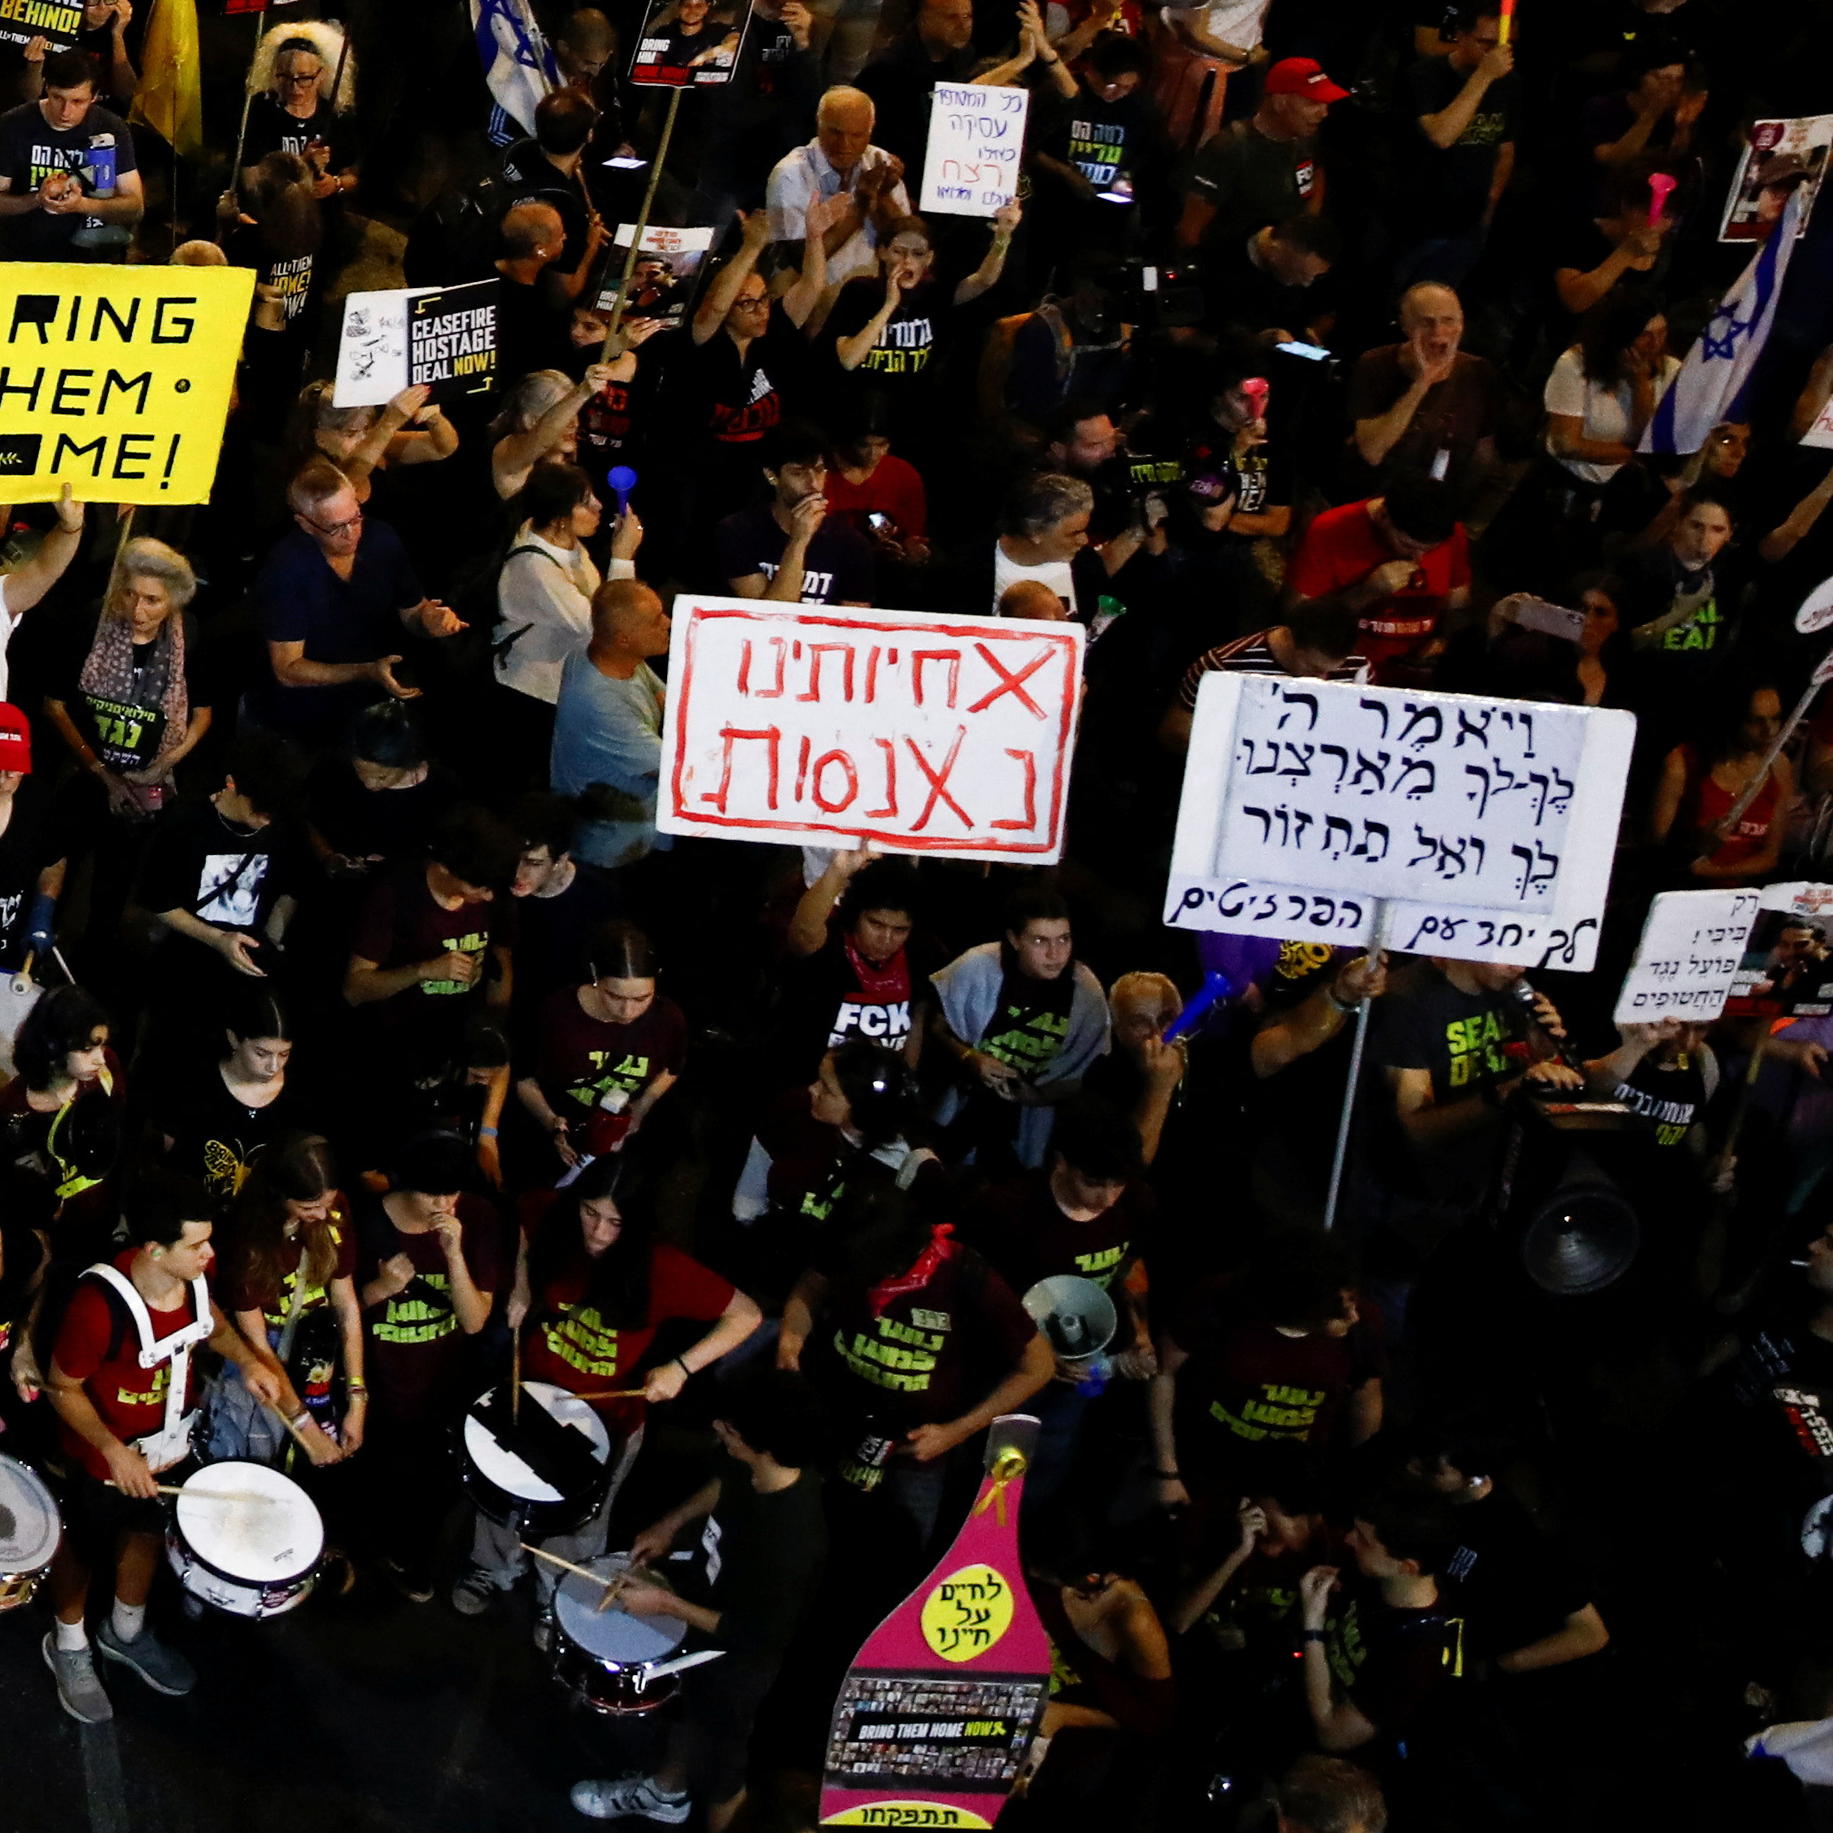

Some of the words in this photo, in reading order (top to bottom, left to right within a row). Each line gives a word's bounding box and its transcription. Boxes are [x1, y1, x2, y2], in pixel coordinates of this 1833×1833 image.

[948, 113, 1008, 141] עסקה
[942, 159, 1002, 188] רצח
[412, 304, 497, 339] CEASEFIRE
[411, 325, 496, 361] HOSTAGE
[411, 361, 452, 387] DEAL
[452, 349, 496, 378] NOW!
[93, 713, 144, 749] נגד
[1243, 802, 1389, 861] תחזור
[1513, 840, 1560, 898] לך
[1731, 894, 1759, 916] רק
[1411, 912, 1467, 947] עם
[1649, 959, 1679, 979] נגד
[1687, 956, 1736, 977] פועל
[1632, 988, 1724, 1013] החטופים
[834, 1002, 912, 1038] FCK
[939, 1573, 1001, 1603] לחיים
[956, 1601, 990, 1629] על
[936, 1625, 990, 1654] חיינו
[858, 1723, 895, 1740] BRING
[896, 1723, 928, 1739] THEM
[929, 1722, 964, 1738] HOME
[861, 1806, 958, 1827] תתפקחו
